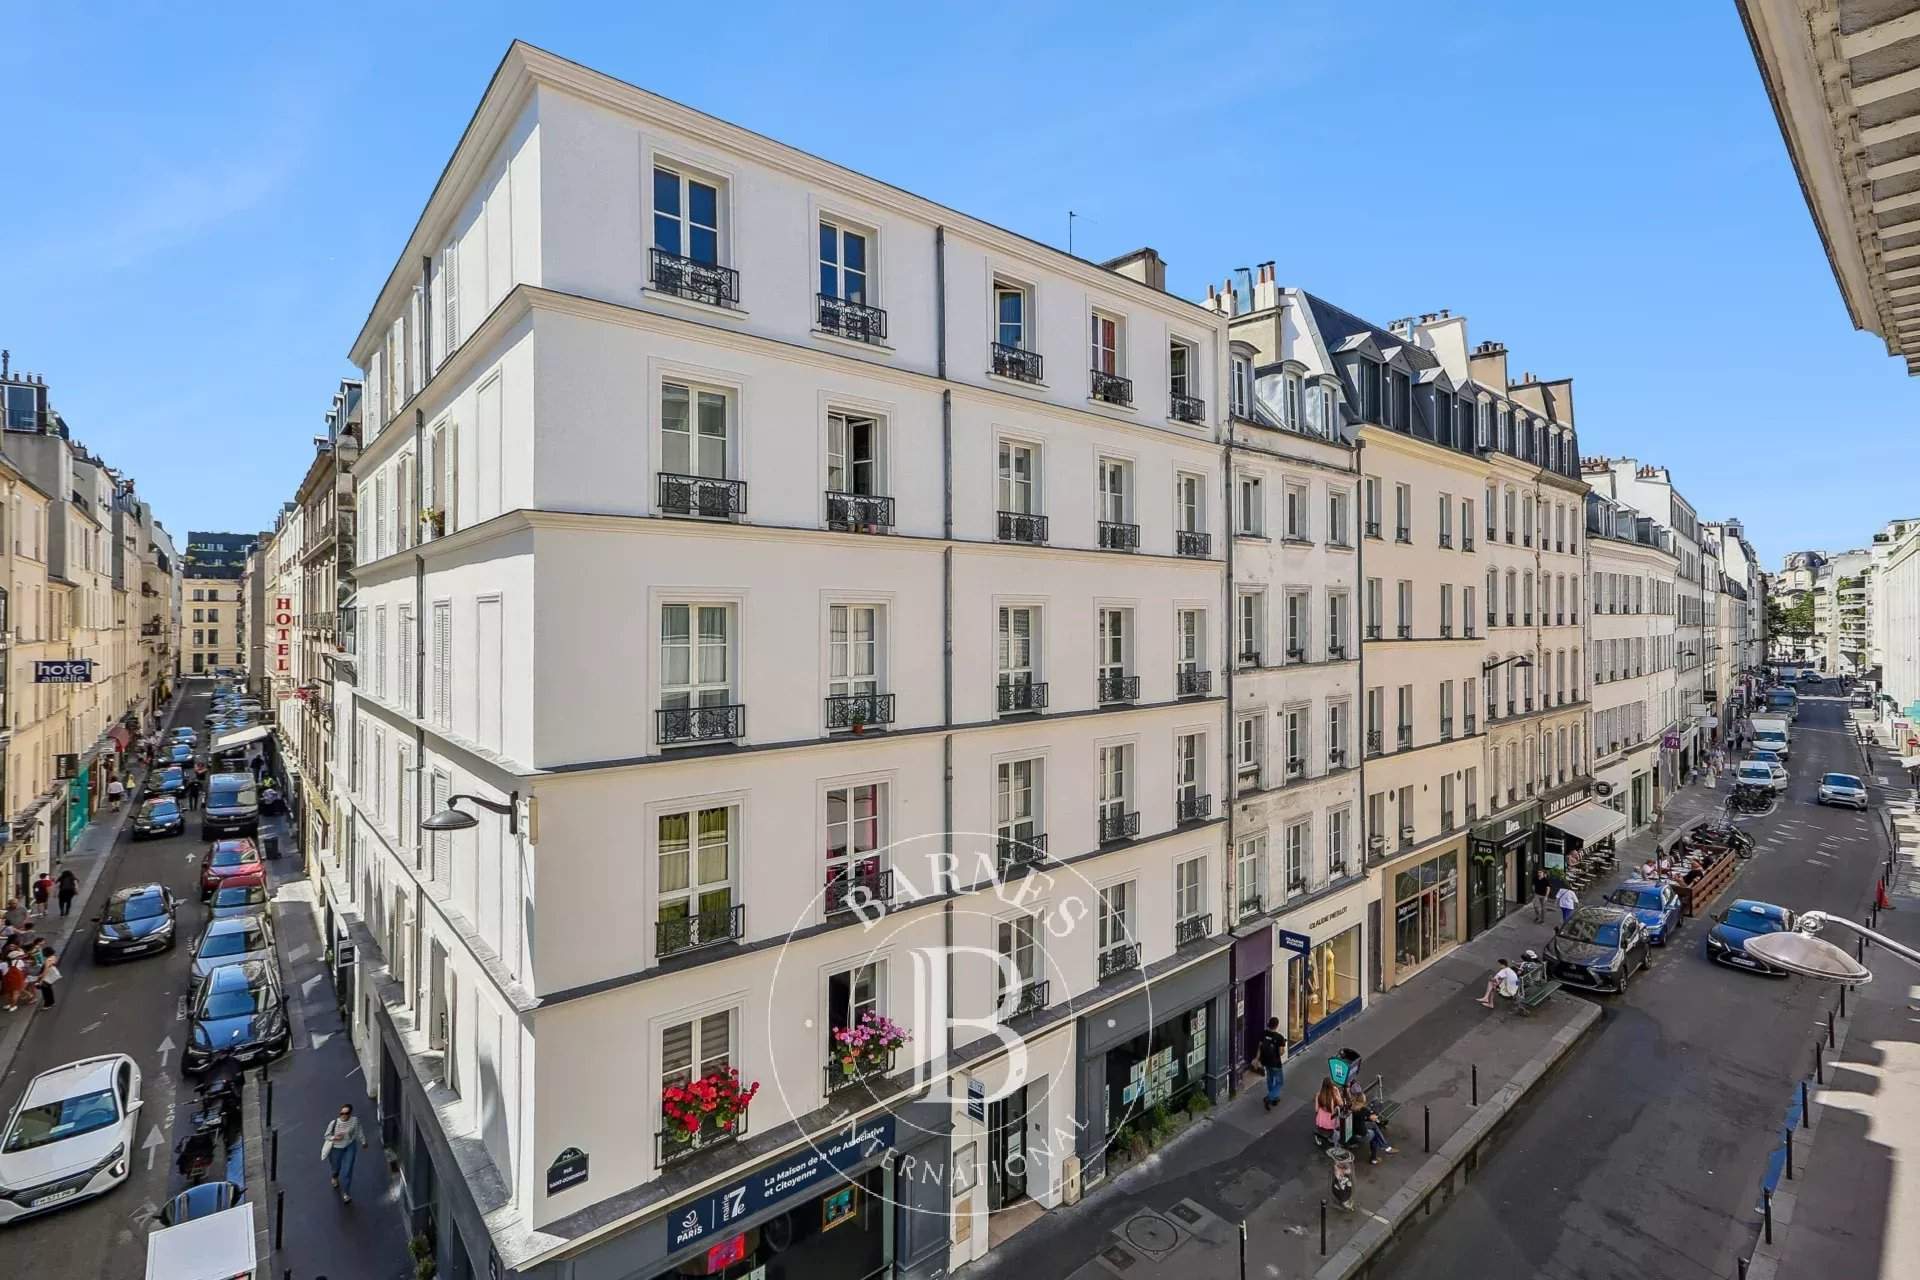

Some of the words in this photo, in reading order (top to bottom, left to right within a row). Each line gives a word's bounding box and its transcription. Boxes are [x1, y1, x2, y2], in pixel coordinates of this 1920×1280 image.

[276, 598, 291, 671] HOTEL
[37, 661, 90, 675] hotel
[764, 1177, 774, 1187] La
[777, 1163, 806, 1181] Maison
[807, 1156, 818, 1167] de
[828, 1145, 841, 1156] Vie
[843, 1126, 885, 1151] Associative
[764, 1188, 773, 1198] et
[775, 1167, 817, 1192] Citoyenne
[722, 1194, 730, 1221] mairie
[677, 1225, 703, 1244] PARIS
